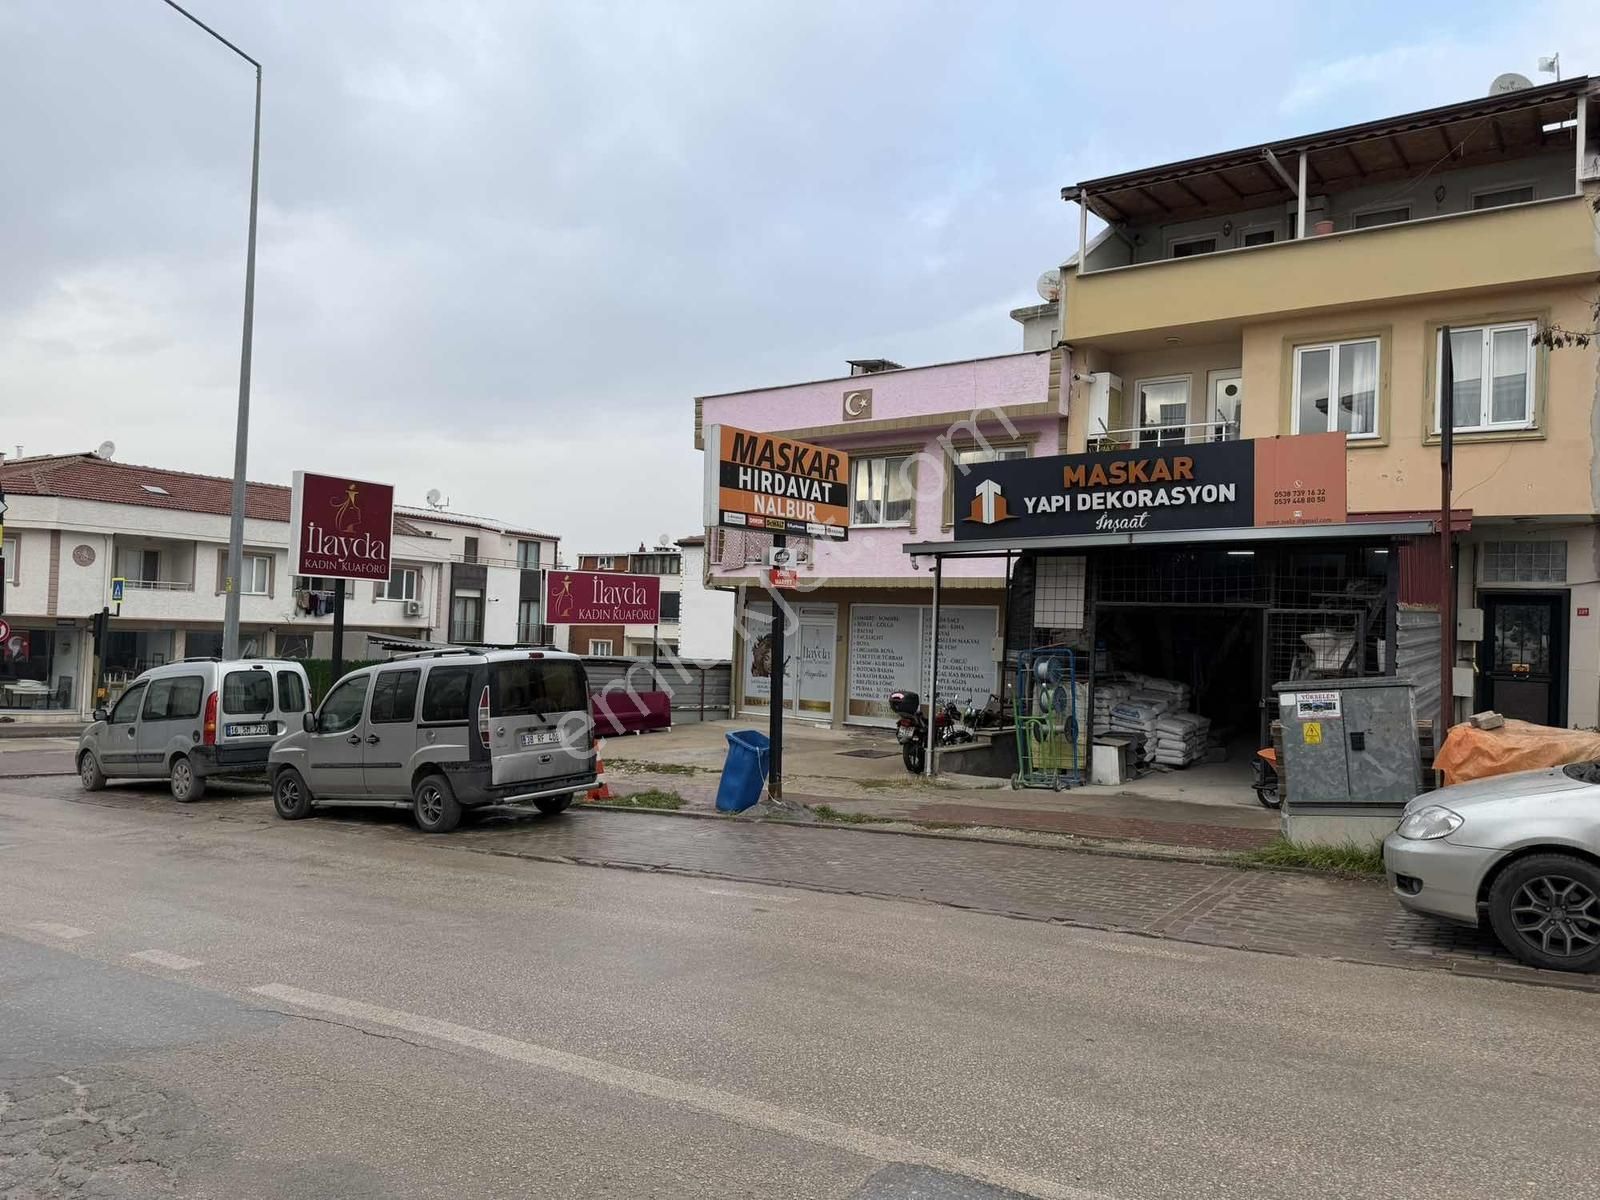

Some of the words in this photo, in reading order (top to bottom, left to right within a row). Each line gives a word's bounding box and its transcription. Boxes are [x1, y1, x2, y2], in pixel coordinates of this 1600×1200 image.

[731, 432, 840, 481] MASKAR
[1063, 456, 1194, 488] MASKAR
[738, 466, 833, 503] HIRDAVAT
[1024, 494, 1071, 514] YAPI
[1077, 483, 1236, 511] DEKORASYON
[753, 494, 817, 521] NALBUR
[1095, 511, 1151, 533] İnşaat
[306, 521, 387, 562] İlayda
[304, 558, 338, 570] KADIN
[592, 576, 647, 610] İlayda
[578, 608, 611, 620] KADIN
